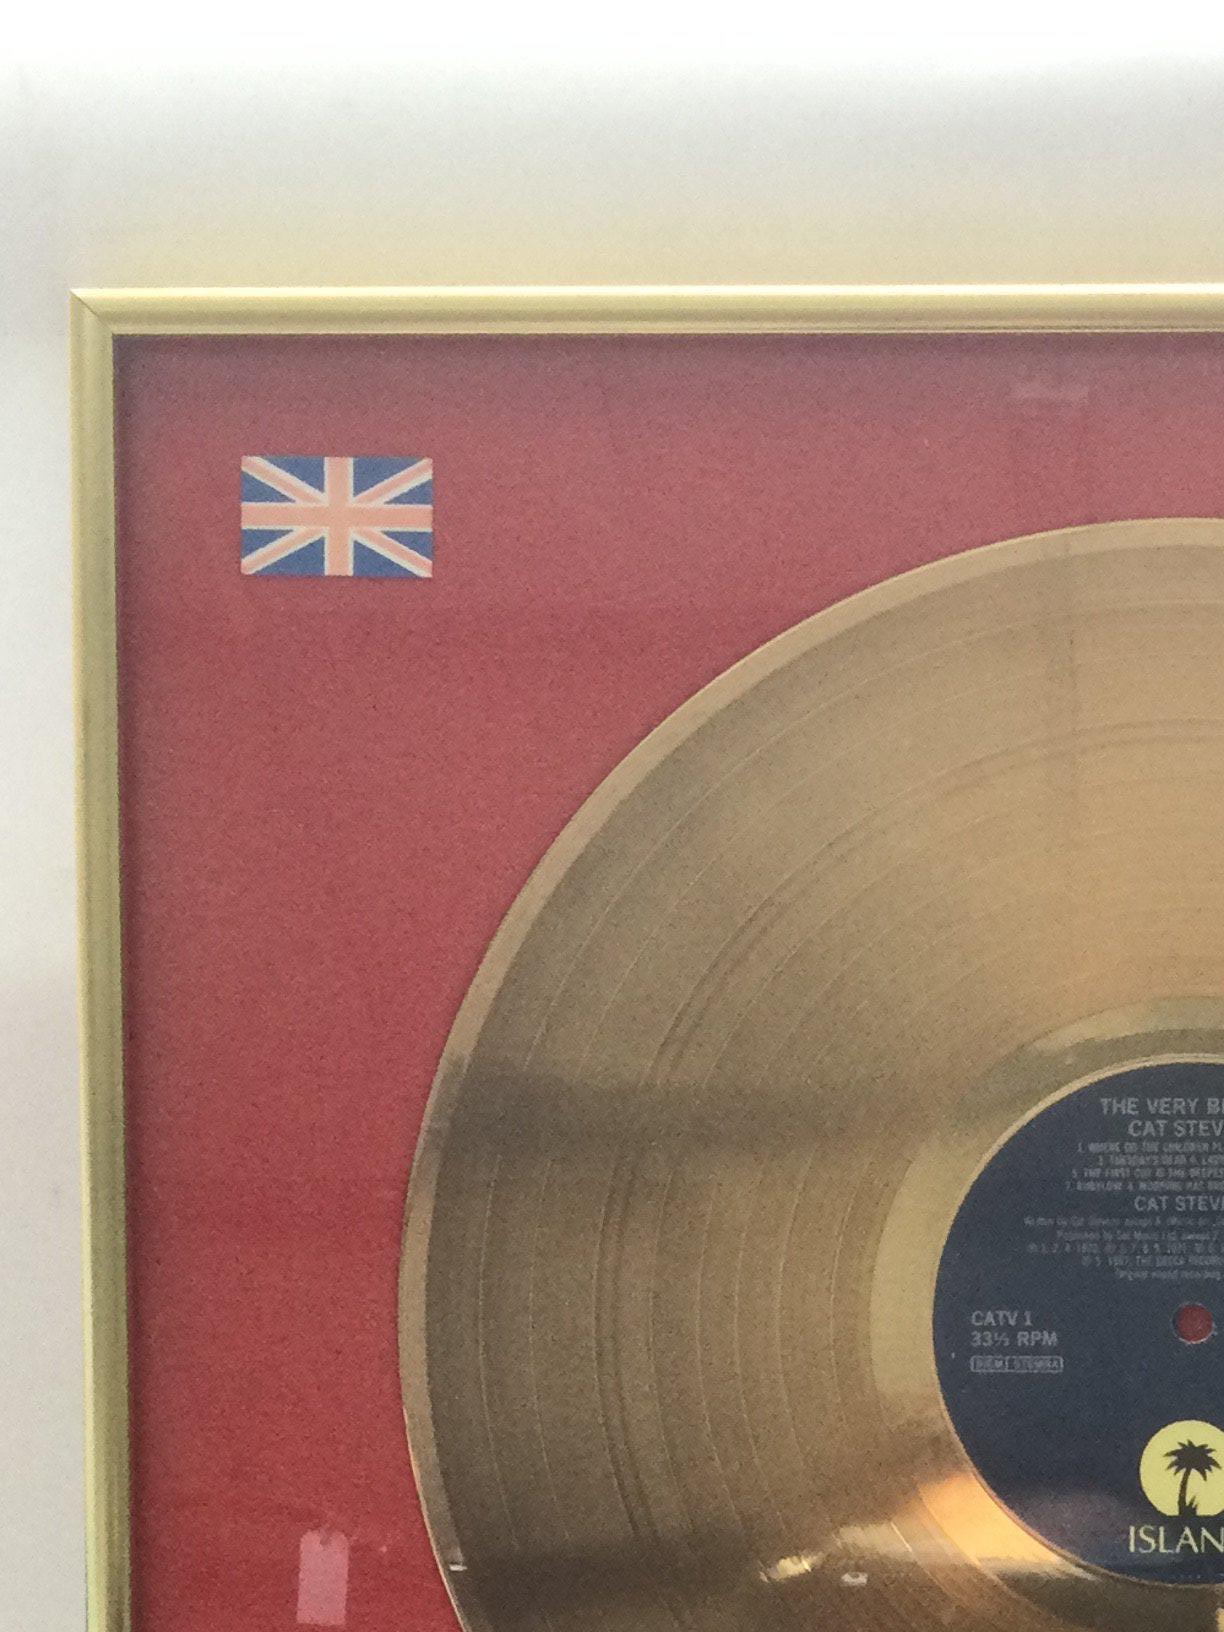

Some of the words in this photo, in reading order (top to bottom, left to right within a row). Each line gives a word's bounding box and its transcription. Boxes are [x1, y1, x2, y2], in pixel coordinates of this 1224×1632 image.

[1100, 1097, 1140, 1116] THE
[1146, 1097, 1199, 1116] VERY
[1128, 1119, 1168, 1137] CAT
[1133, 1196, 1168, 1212] CAT
[971, 1310, 1018, 1326] CATV
[1024, 1310, 1033, 1326] 1
[1017, 1330, 1058, 1346] RPM
